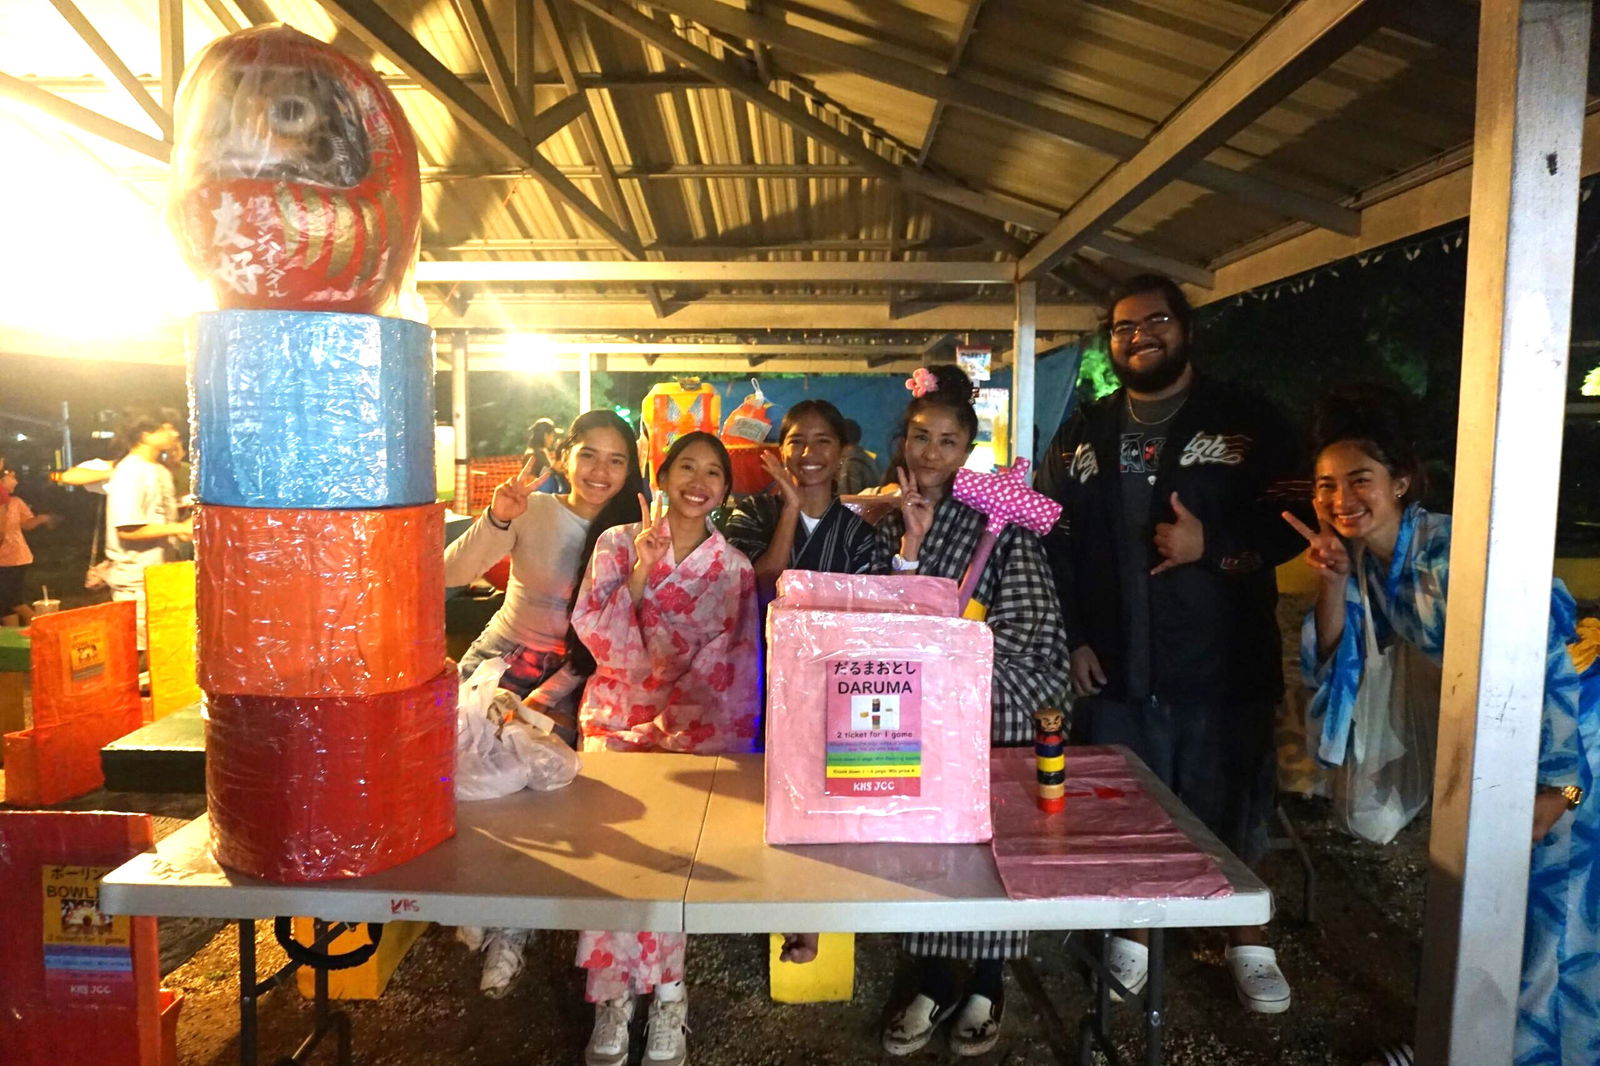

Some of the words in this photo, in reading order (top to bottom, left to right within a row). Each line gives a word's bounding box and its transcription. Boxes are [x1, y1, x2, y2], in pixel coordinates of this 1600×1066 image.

[834, 661, 916, 675] だるまおとし
[838, 681, 913, 694] DARUMA
[874, 781, 895, 791] JCC
